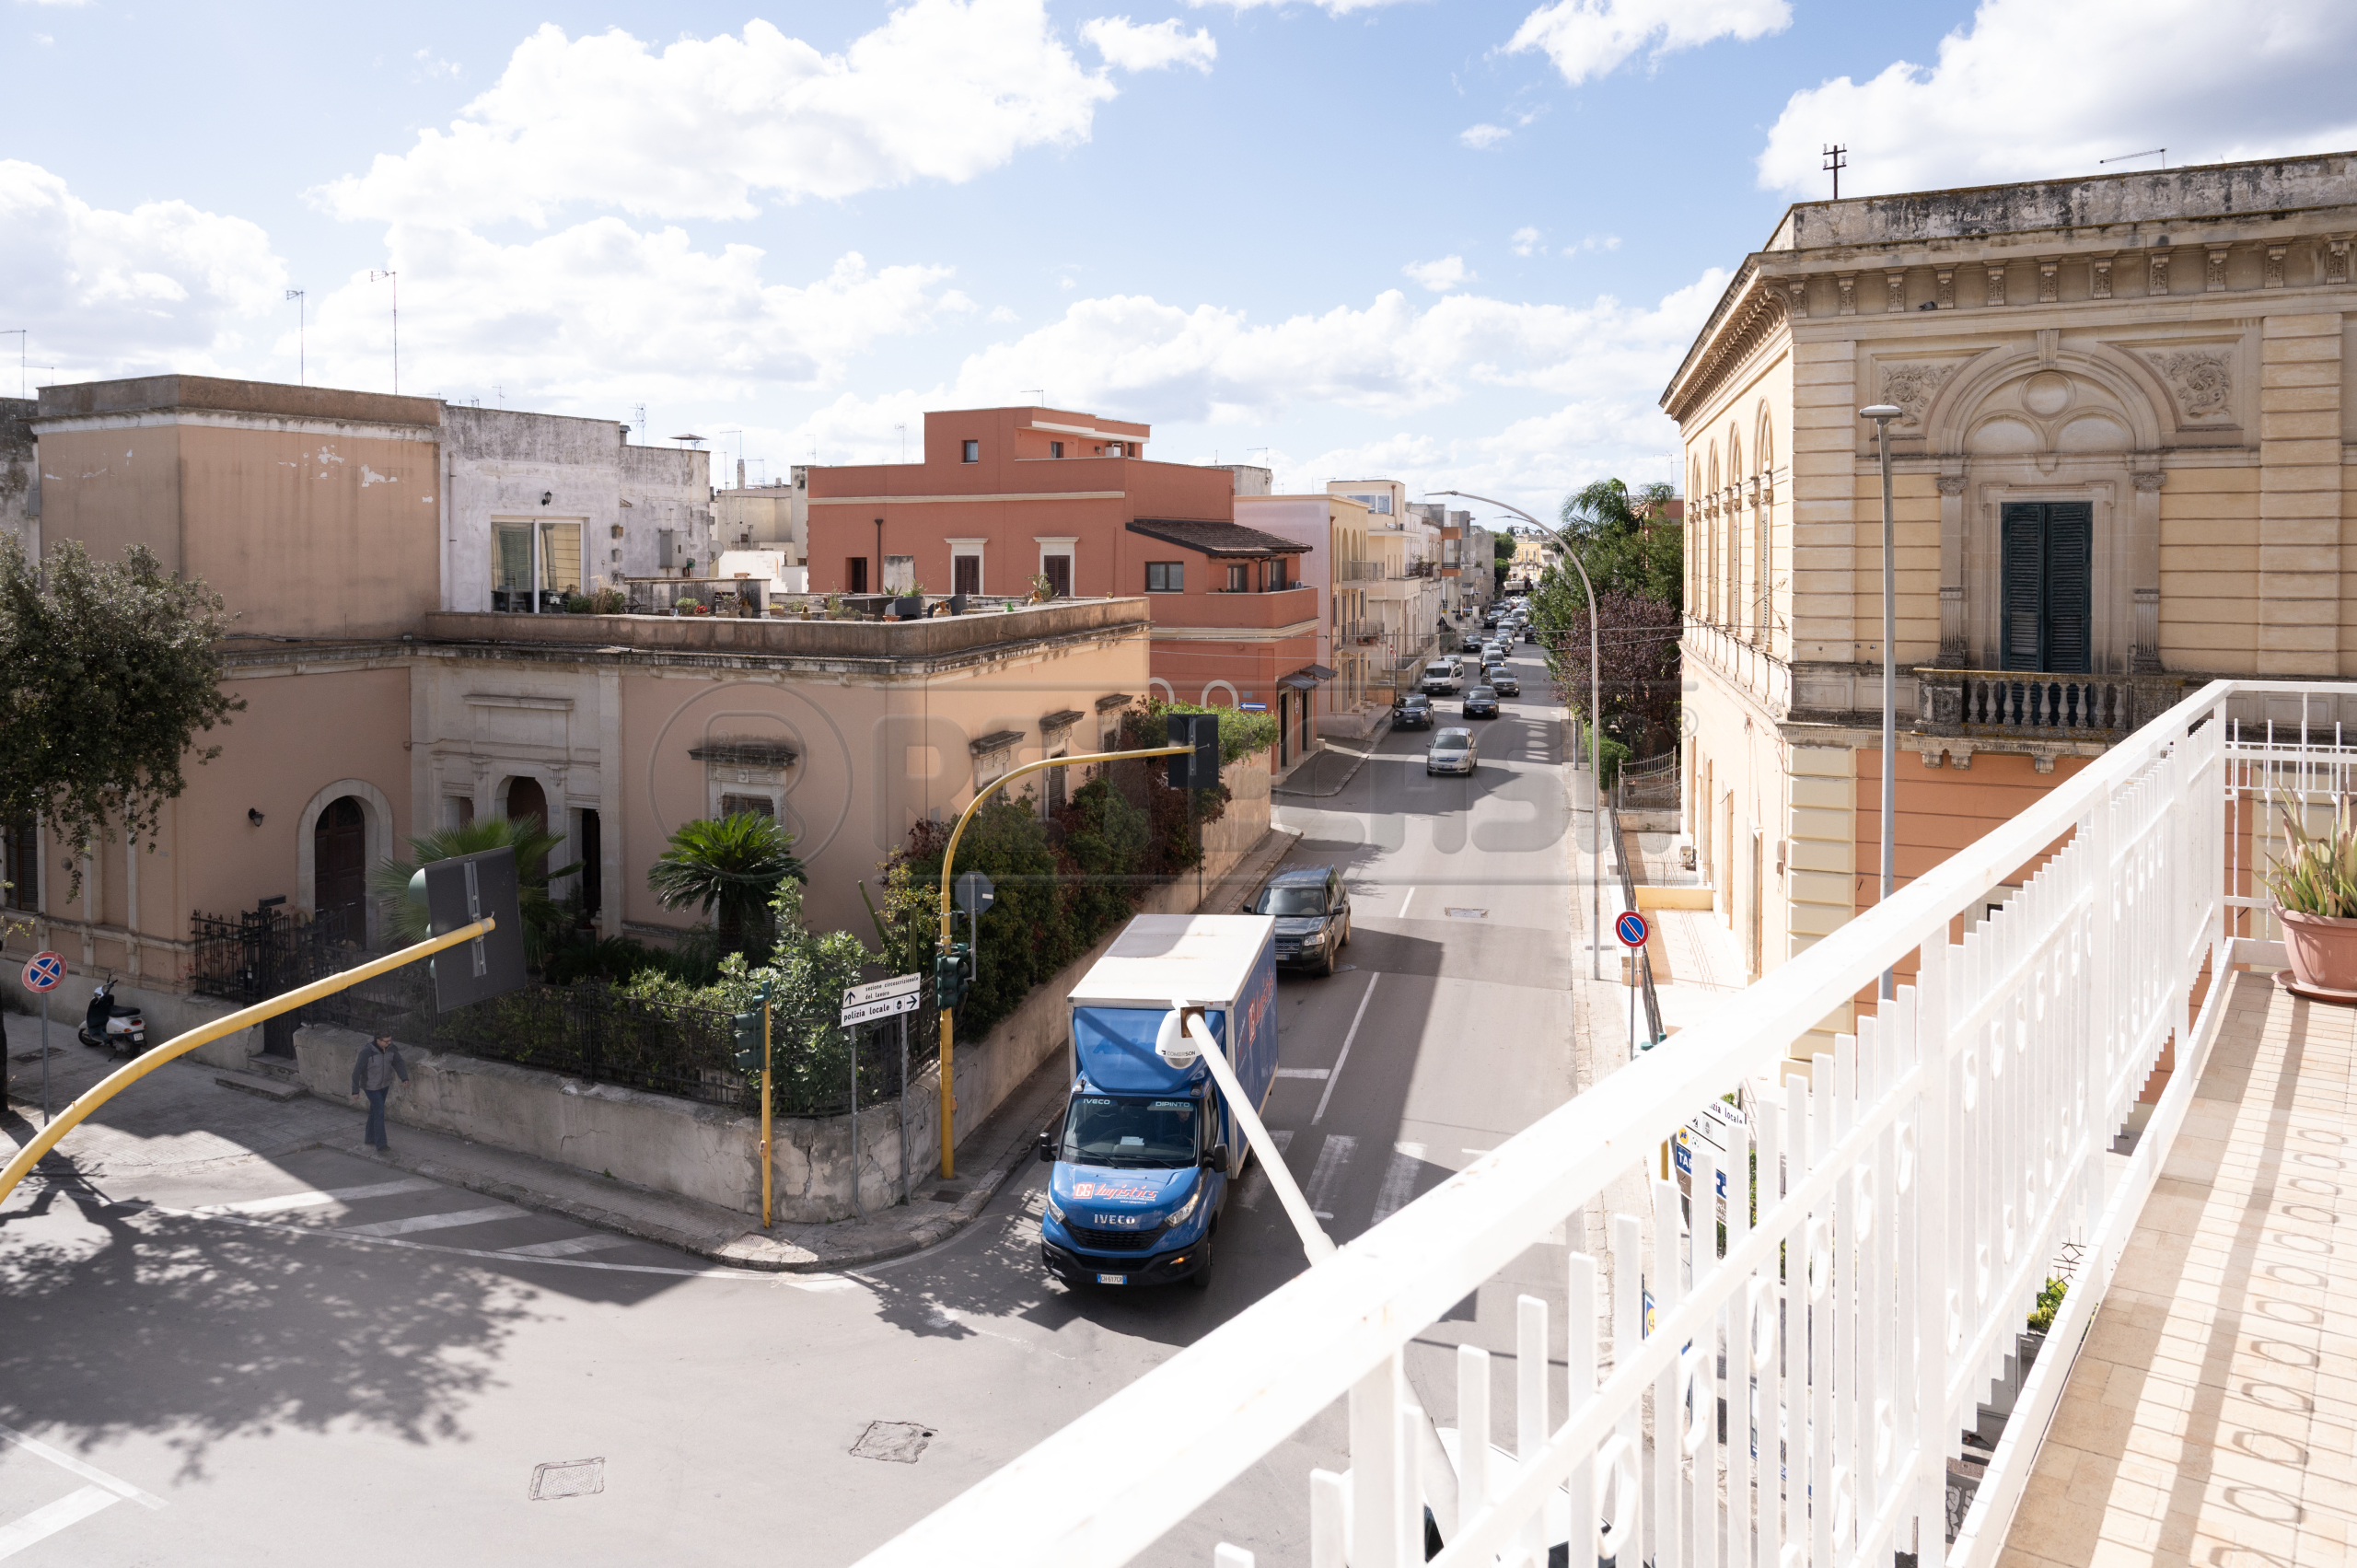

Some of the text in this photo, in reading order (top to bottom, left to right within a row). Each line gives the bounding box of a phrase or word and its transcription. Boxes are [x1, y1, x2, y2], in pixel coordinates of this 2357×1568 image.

[865, 983, 882, 992] sezione
[843, 1004, 890, 1023] polizia locale
[1075, 1182, 1159, 1200] CG logistics
[1094, 1214, 1136, 1225] IVECO
